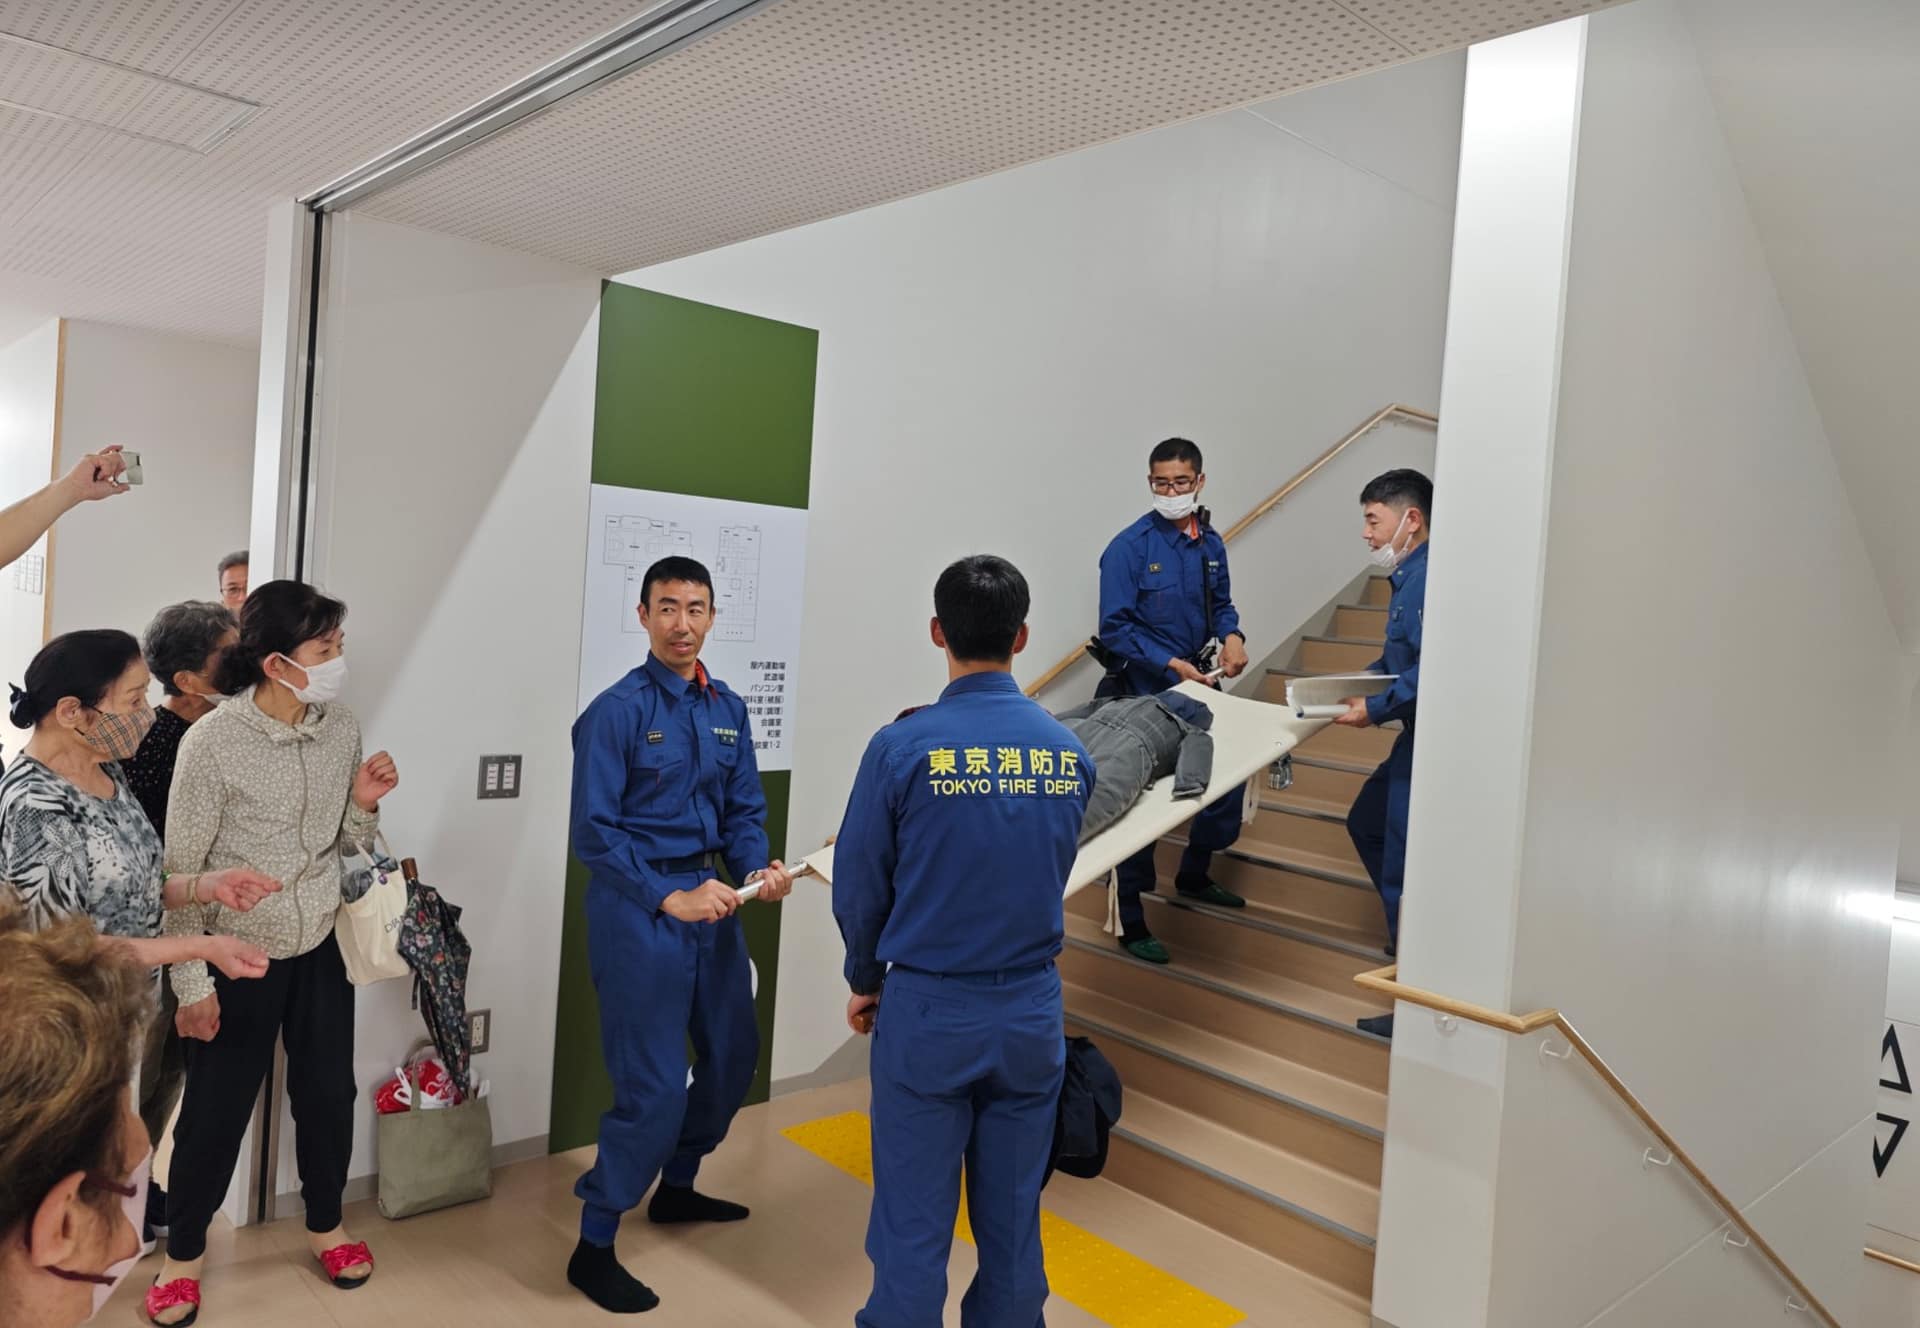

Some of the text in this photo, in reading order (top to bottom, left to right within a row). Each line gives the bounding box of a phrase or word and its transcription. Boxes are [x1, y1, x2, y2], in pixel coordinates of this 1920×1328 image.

[750, 684, 784, 693] パソコン室
[928, 747, 1079, 777] 東京消防庁
[929, 779, 1081, 796] TOKYO FIRE DEPT.
